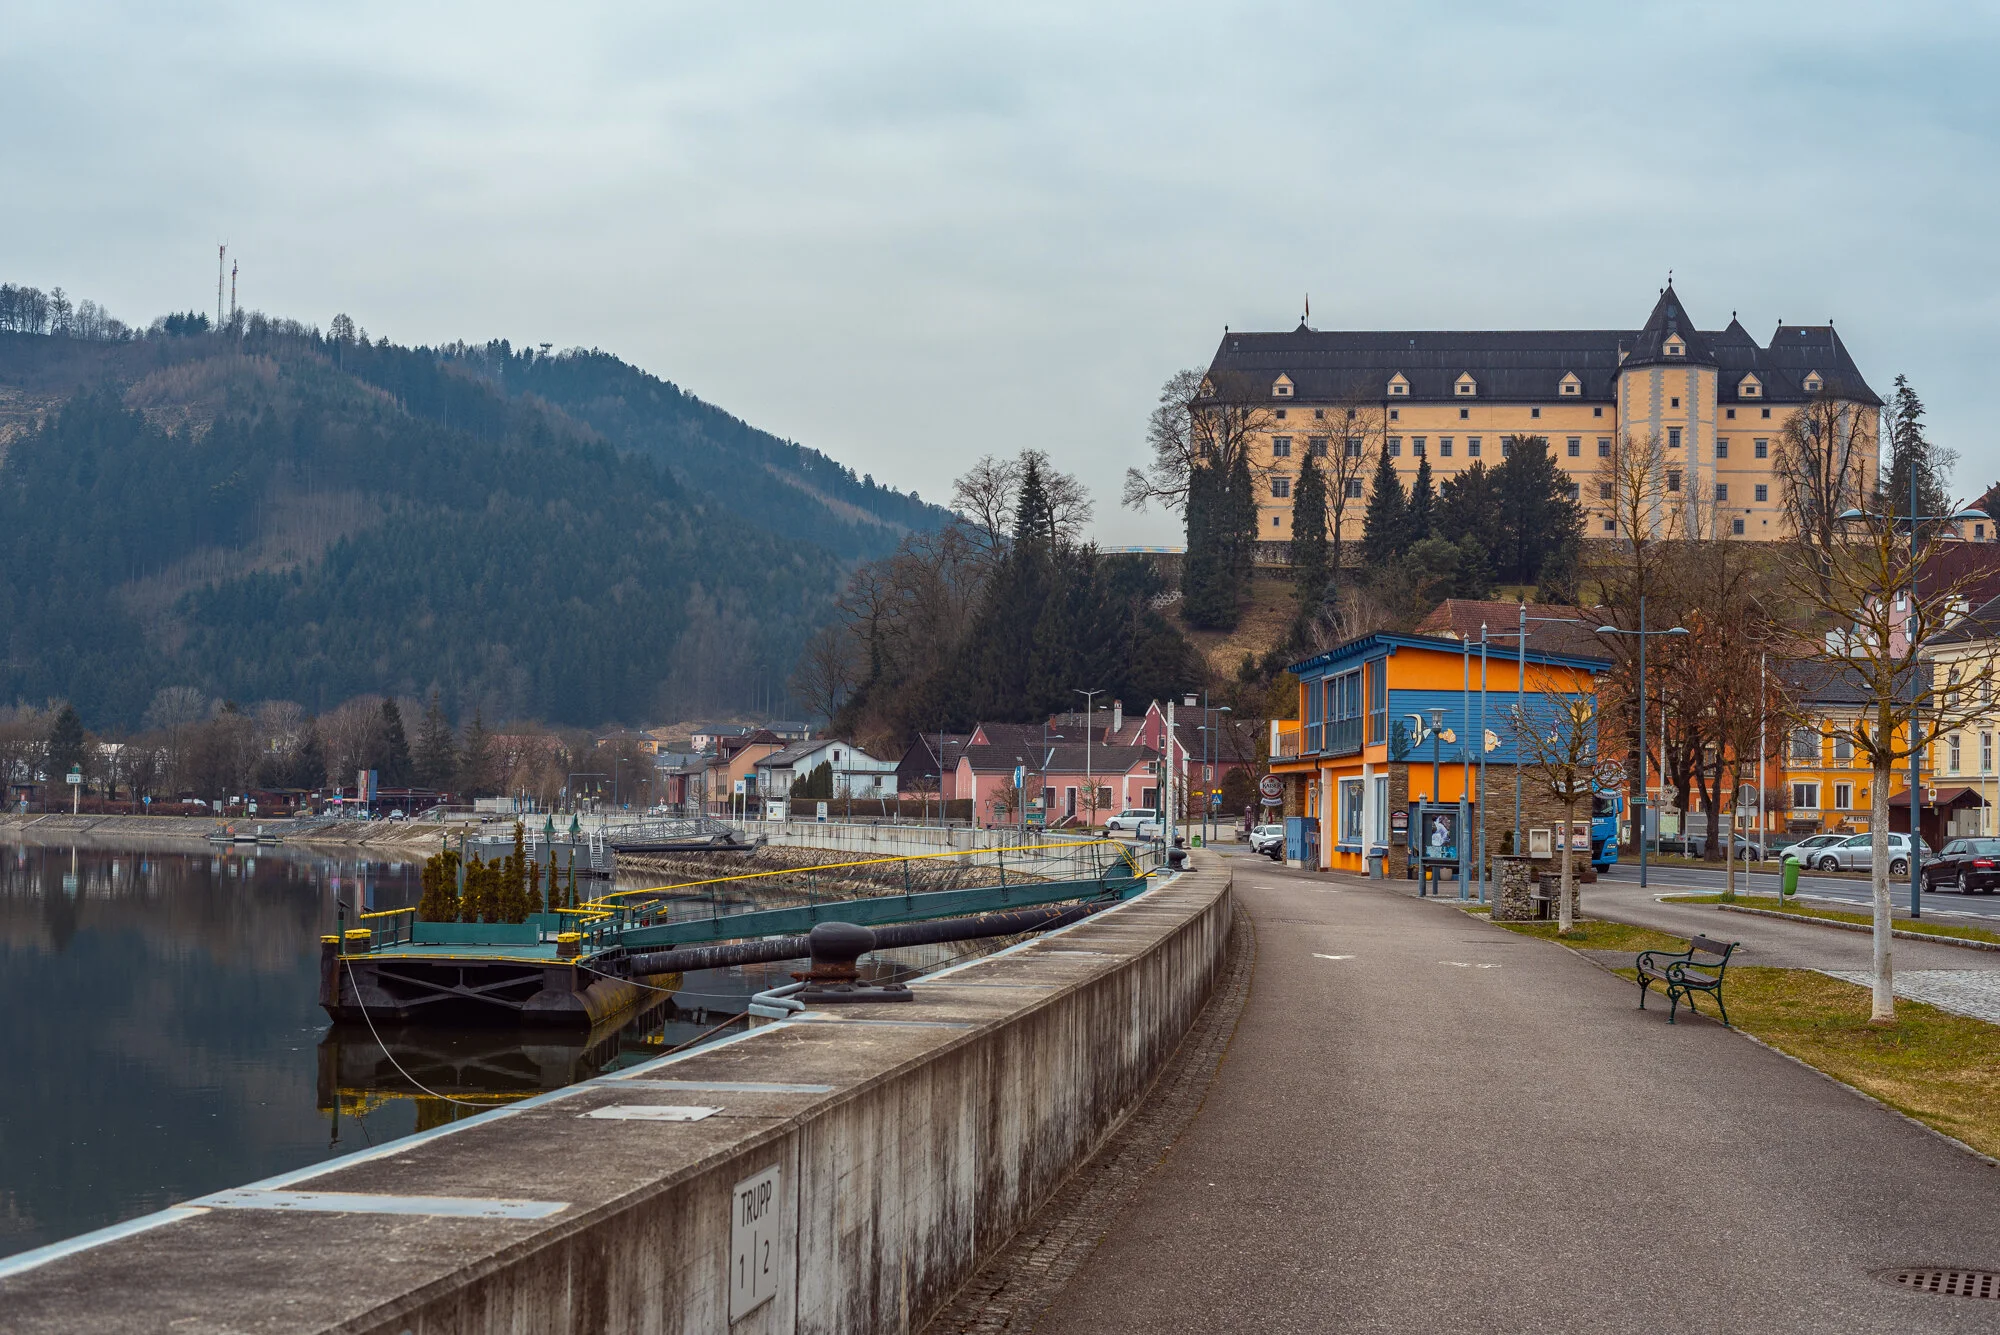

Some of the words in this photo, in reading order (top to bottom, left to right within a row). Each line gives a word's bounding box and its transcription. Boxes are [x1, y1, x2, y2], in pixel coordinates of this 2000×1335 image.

[740, 1180, 772, 1227] TRUPP
[739, 1253, 745, 1289] 1
[763, 1239, 770, 1275] 2
